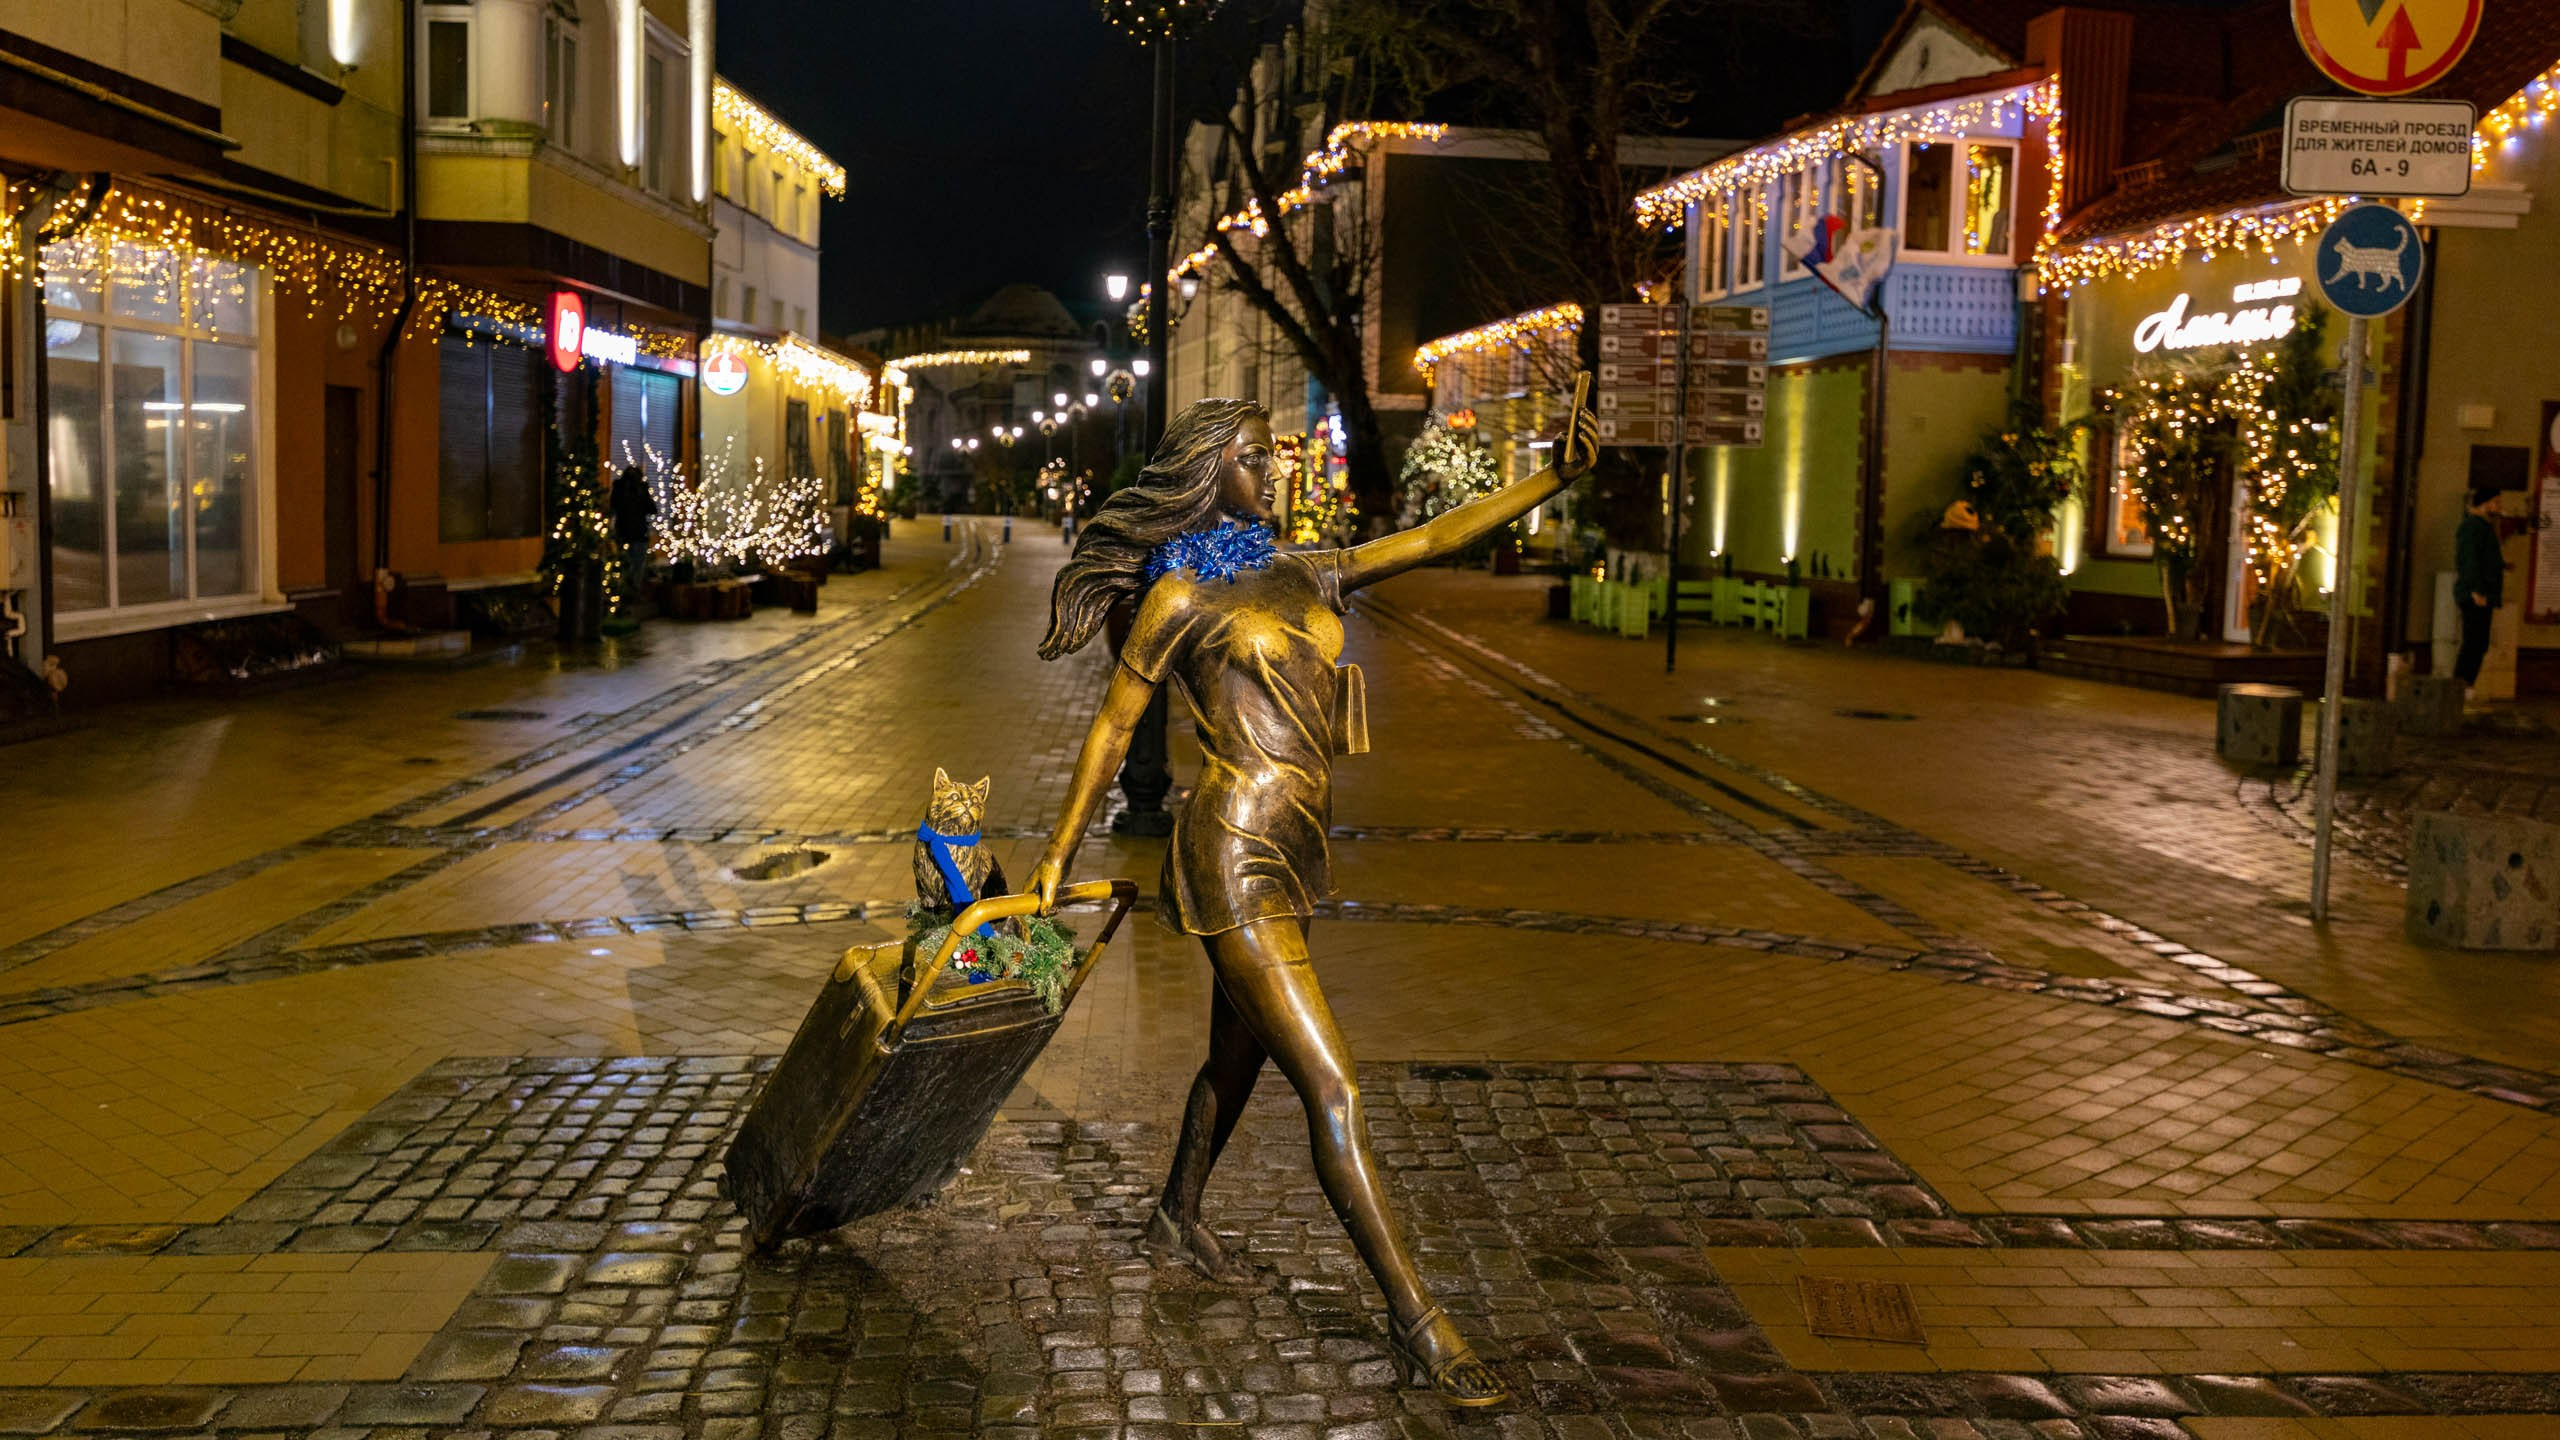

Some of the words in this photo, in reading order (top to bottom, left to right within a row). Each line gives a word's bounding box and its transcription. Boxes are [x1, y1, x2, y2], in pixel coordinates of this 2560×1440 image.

[2299, 119, 2400, 134] ВРЕМЕННЫЙ
[2404, 123, 2467, 138] ПРОЕЗД
[2294, 140, 2327, 153] ДЛЯ
[2331, 138, 2407, 154] ЖИТЕЛЕЙ
[2409, 140, 2468, 155] ДОМОВ
[2350, 158, 2378, 176] 6А
[2397, 159, 2410, 177] 9
